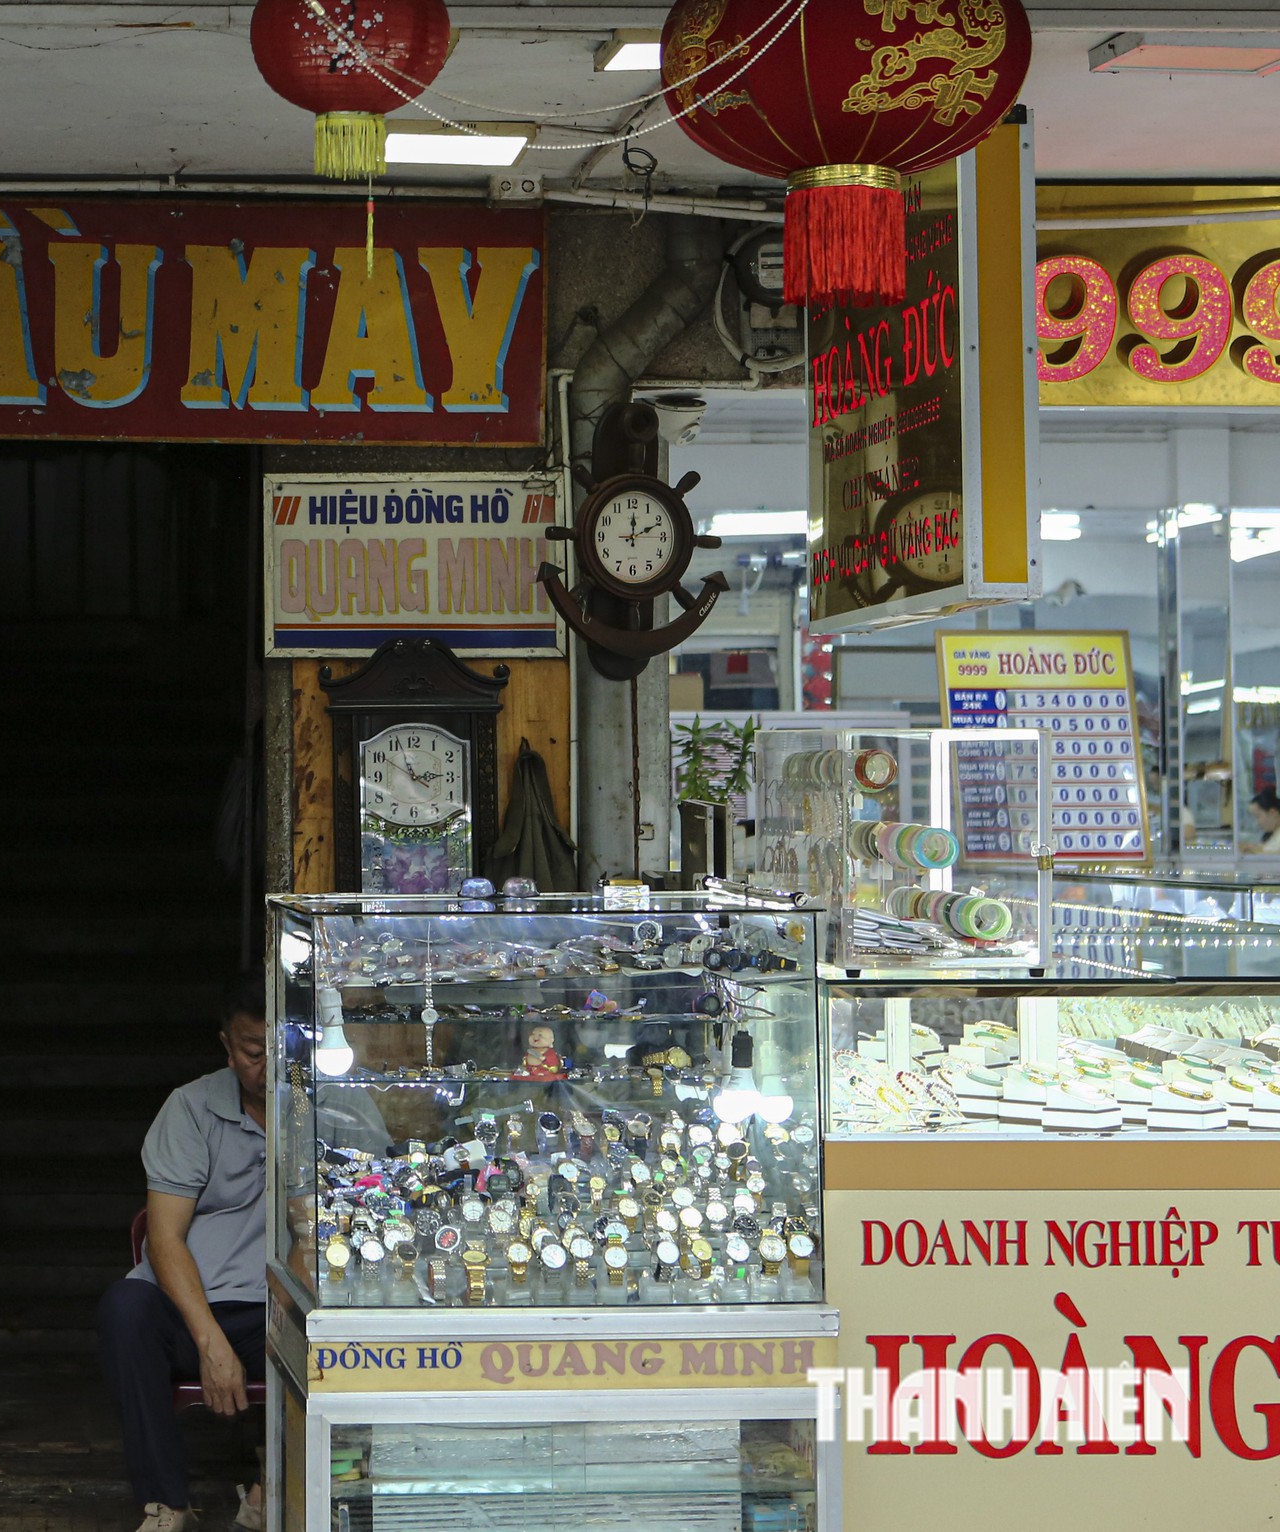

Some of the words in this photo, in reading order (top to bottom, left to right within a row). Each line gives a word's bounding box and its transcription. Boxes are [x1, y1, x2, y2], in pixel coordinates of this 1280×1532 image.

[180, 244, 541, 413] MAY
[812, 316, 892, 428] HOÀNG
[902, 269, 956, 386] ĐỨC
[308, 489, 378, 534] HIỆU
[383, 486, 464, 524] ĐỒNG
[471, 486, 513, 524] HỒ
[613, 503, 621, 514] 11
[627, 498, 638, 510] 12
[645, 503, 650, 514] 1
[601, 516, 611, 527] 10
[655, 515, 662, 526] 2
[598, 531, 605, 543] 9
[660, 532, 667, 543] 3
[900, 511, 931, 562] VÀNG
[934, 508, 959, 563] BẠC
[602, 548, 610, 559] 8
[656, 548, 663, 559] 4
[615, 561, 622, 572] 7
[629, 565, 636, 576] 6
[645, 561, 652, 571] 5
[280, 537, 429, 621] QUANG
[437, 536, 551, 616] MINH
[699, 592, 717, 617] Classic
[954, 650, 966, 660] GIÁ
[968, 650, 991, 660] VÀNG
[998, 648, 1067, 675] HOÀNG
[1073, 647, 1115, 675] ĐỨC
[958, 665, 987, 676] 9999
[954, 691, 975, 701] BÁN
[976, 693, 988, 701] RA
[962, 702, 983, 710] 24K
[952, 716, 973, 724] MUA
[974, 715, 995, 724] VÀO
[388, 739, 400, 751] 11
[407, 736, 421, 748] 12
[431, 739, 436, 751] 1
[373, 751, 386, 763] 10
[445, 751, 454, 763] 2
[374, 771, 383, 783] 9
[446, 772, 454, 783] 3
[375, 792, 384, 804] 8
[445, 791, 454, 803] 4
[390, 803, 399, 815] 7
[410, 806, 418, 819] 6
[431, 804, 439, 815] 5
[860, 1219, 1029, 1268] DOANH
[1044, 1206, 1219, 1279] NGHIỆP
[317, 1341, 407, 1370] ĐỒNG
[416, 1340, 463, 1369] HỒ
[479, 1342, 666, 1385] QUANG
[679, 1340, 816, 1376] MINH
[866, 1291, 1280, 1460] HOÀNG
